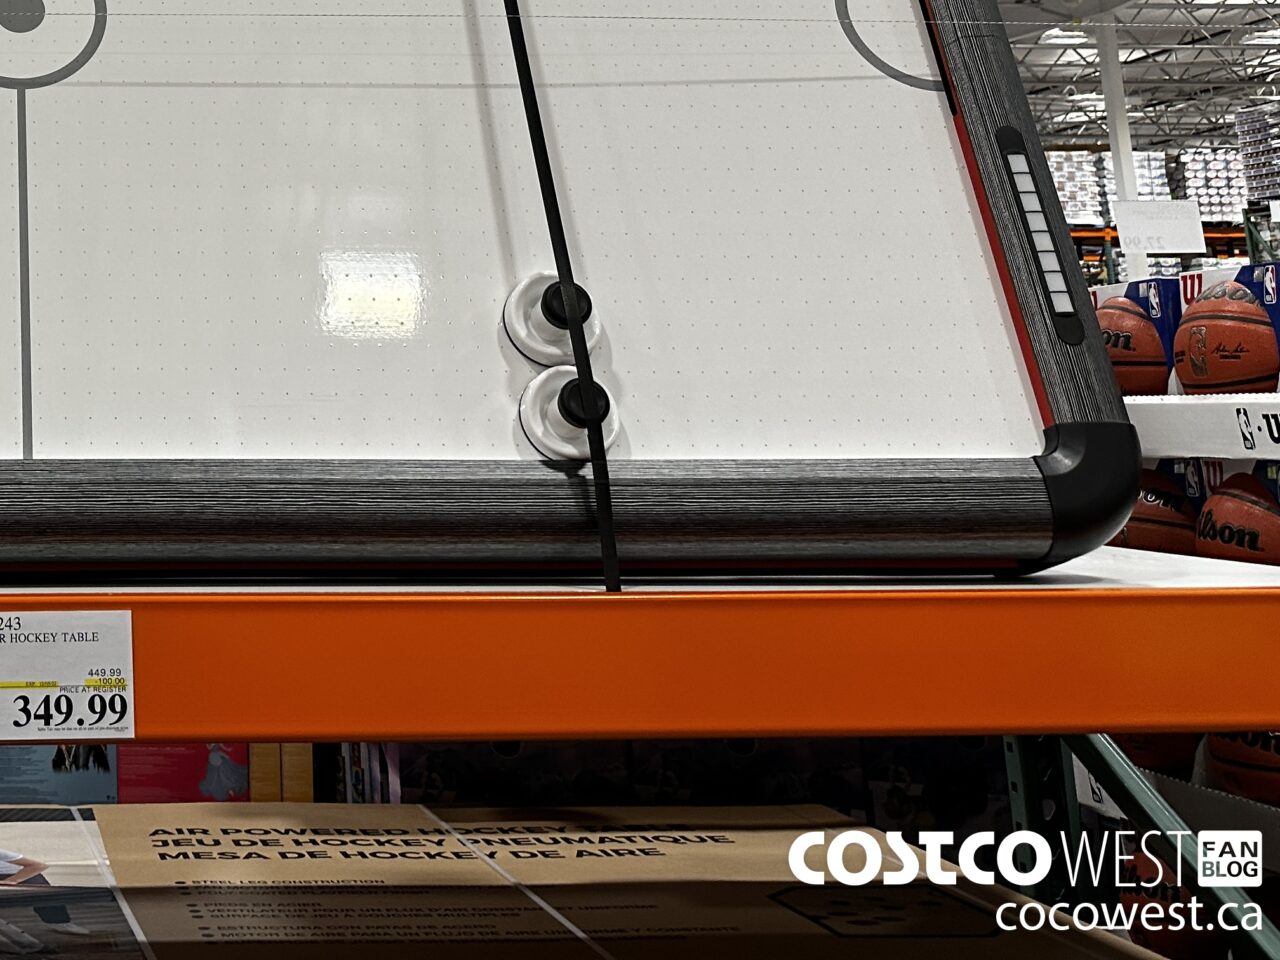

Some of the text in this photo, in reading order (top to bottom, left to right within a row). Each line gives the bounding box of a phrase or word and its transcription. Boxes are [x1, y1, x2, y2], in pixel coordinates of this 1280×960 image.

[10, 632, 57, 644] HOCKEY
[61, 632, 99, 643] TABLE
[88, 668, 122, 677] 449.99
[93, 685, 126, 693] REGISTER
[13, 694, 127, 727] 349.99
[149, 828, 211, 836] AIR
[220, 828, 410, 836] POWERED
[417, 826, 566, 836] HOCKEY
[151, 835, 736, 847] JEU DE HOCKEY PNEUMATIQUE
[158, 848, 667, 860] MESA DE HOCKEY DE AIRE
